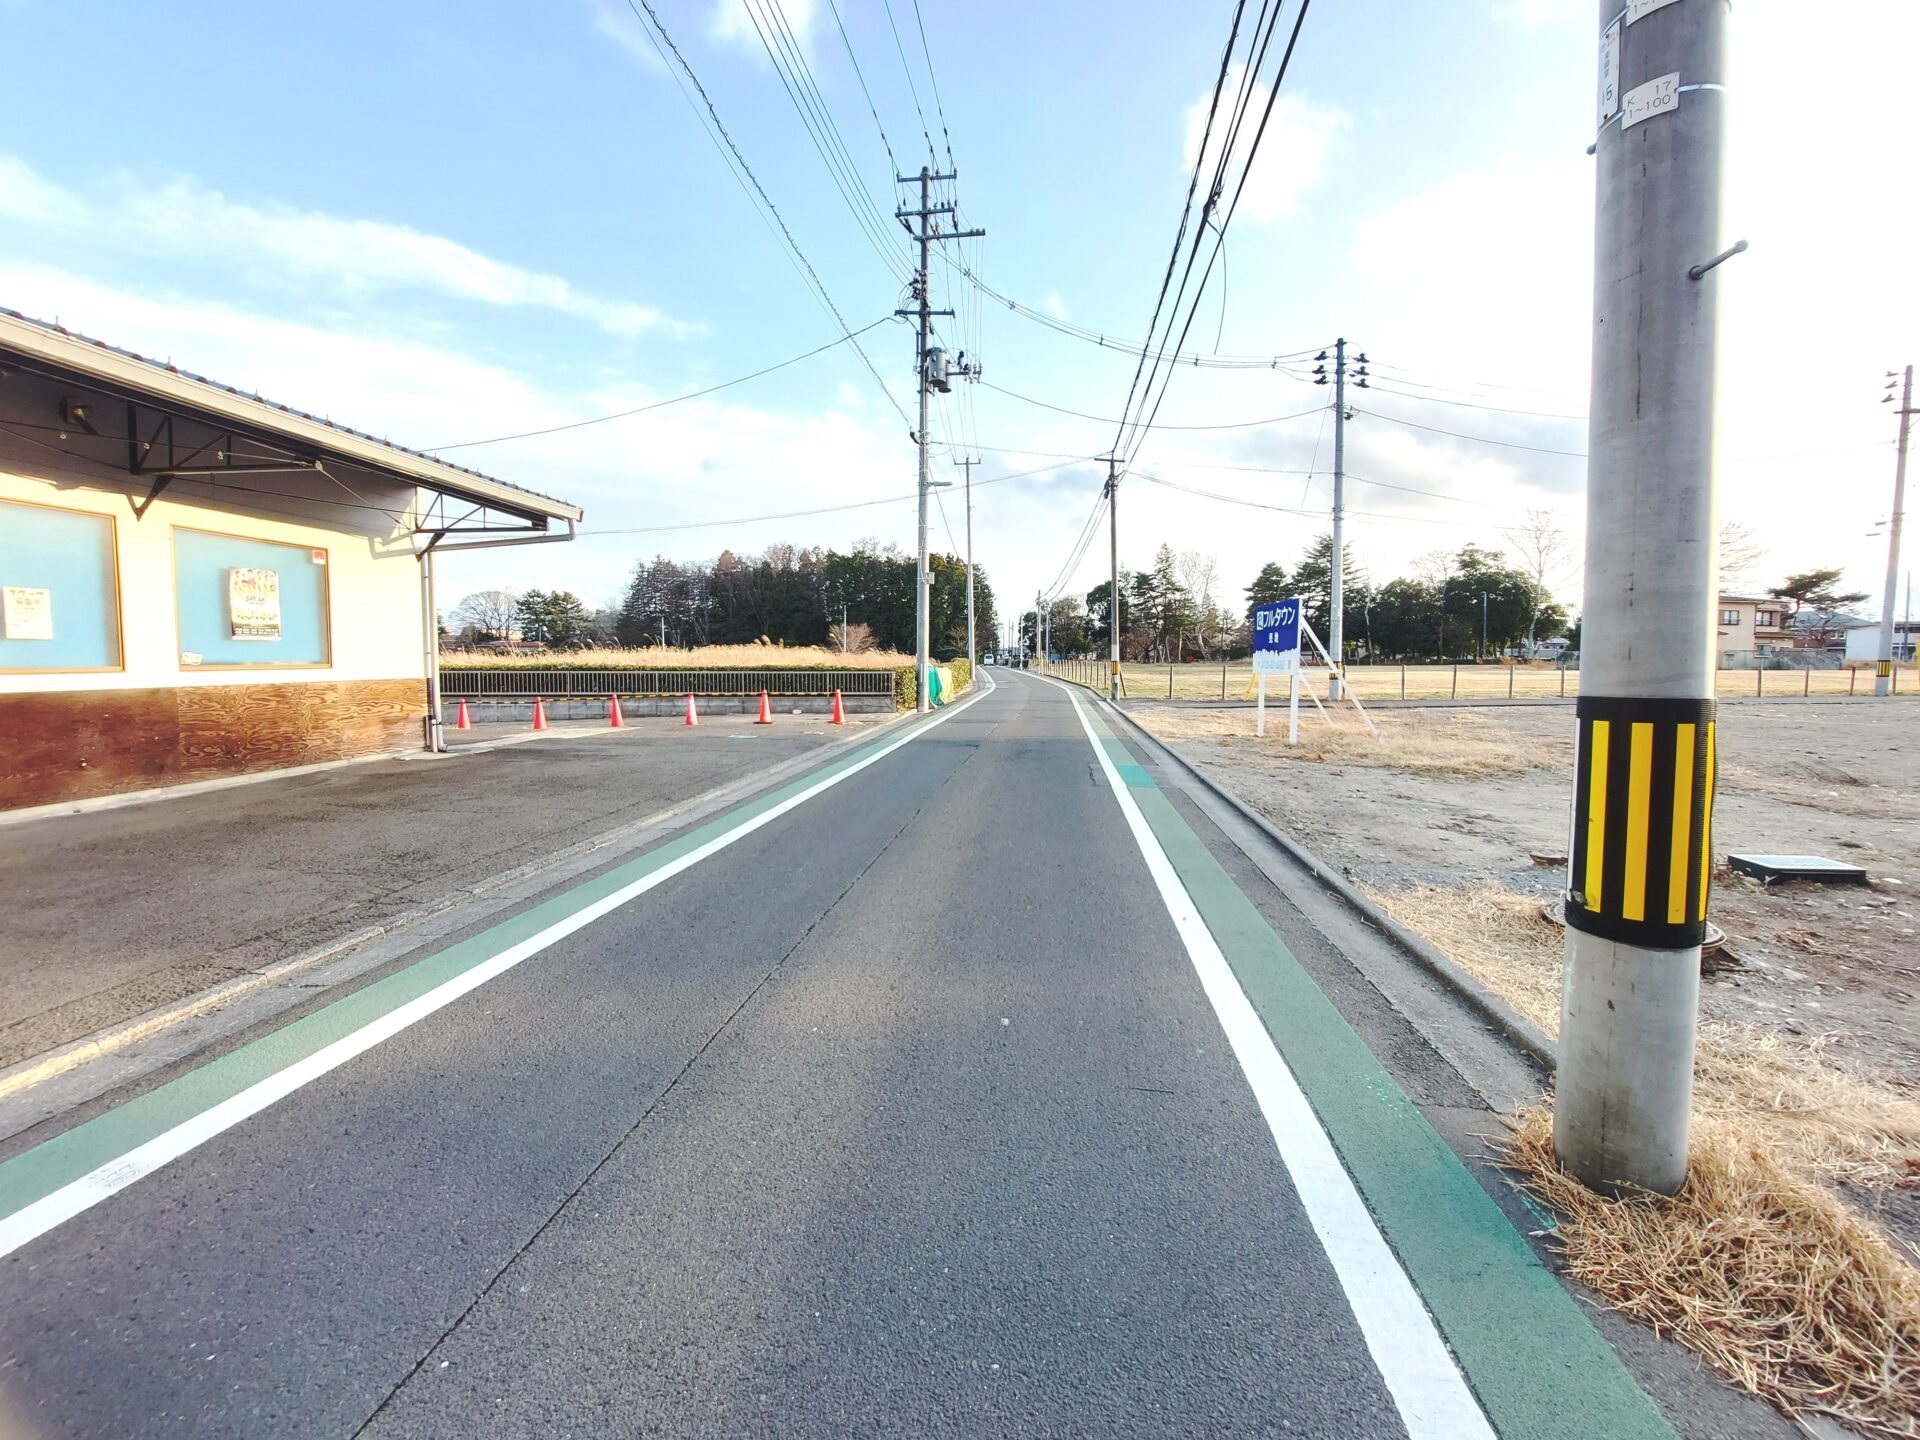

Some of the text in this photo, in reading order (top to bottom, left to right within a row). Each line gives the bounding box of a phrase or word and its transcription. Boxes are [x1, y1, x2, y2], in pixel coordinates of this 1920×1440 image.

[1602, 84, 1613, 106] 15
[1627, 81, 1671, 107] K 17
